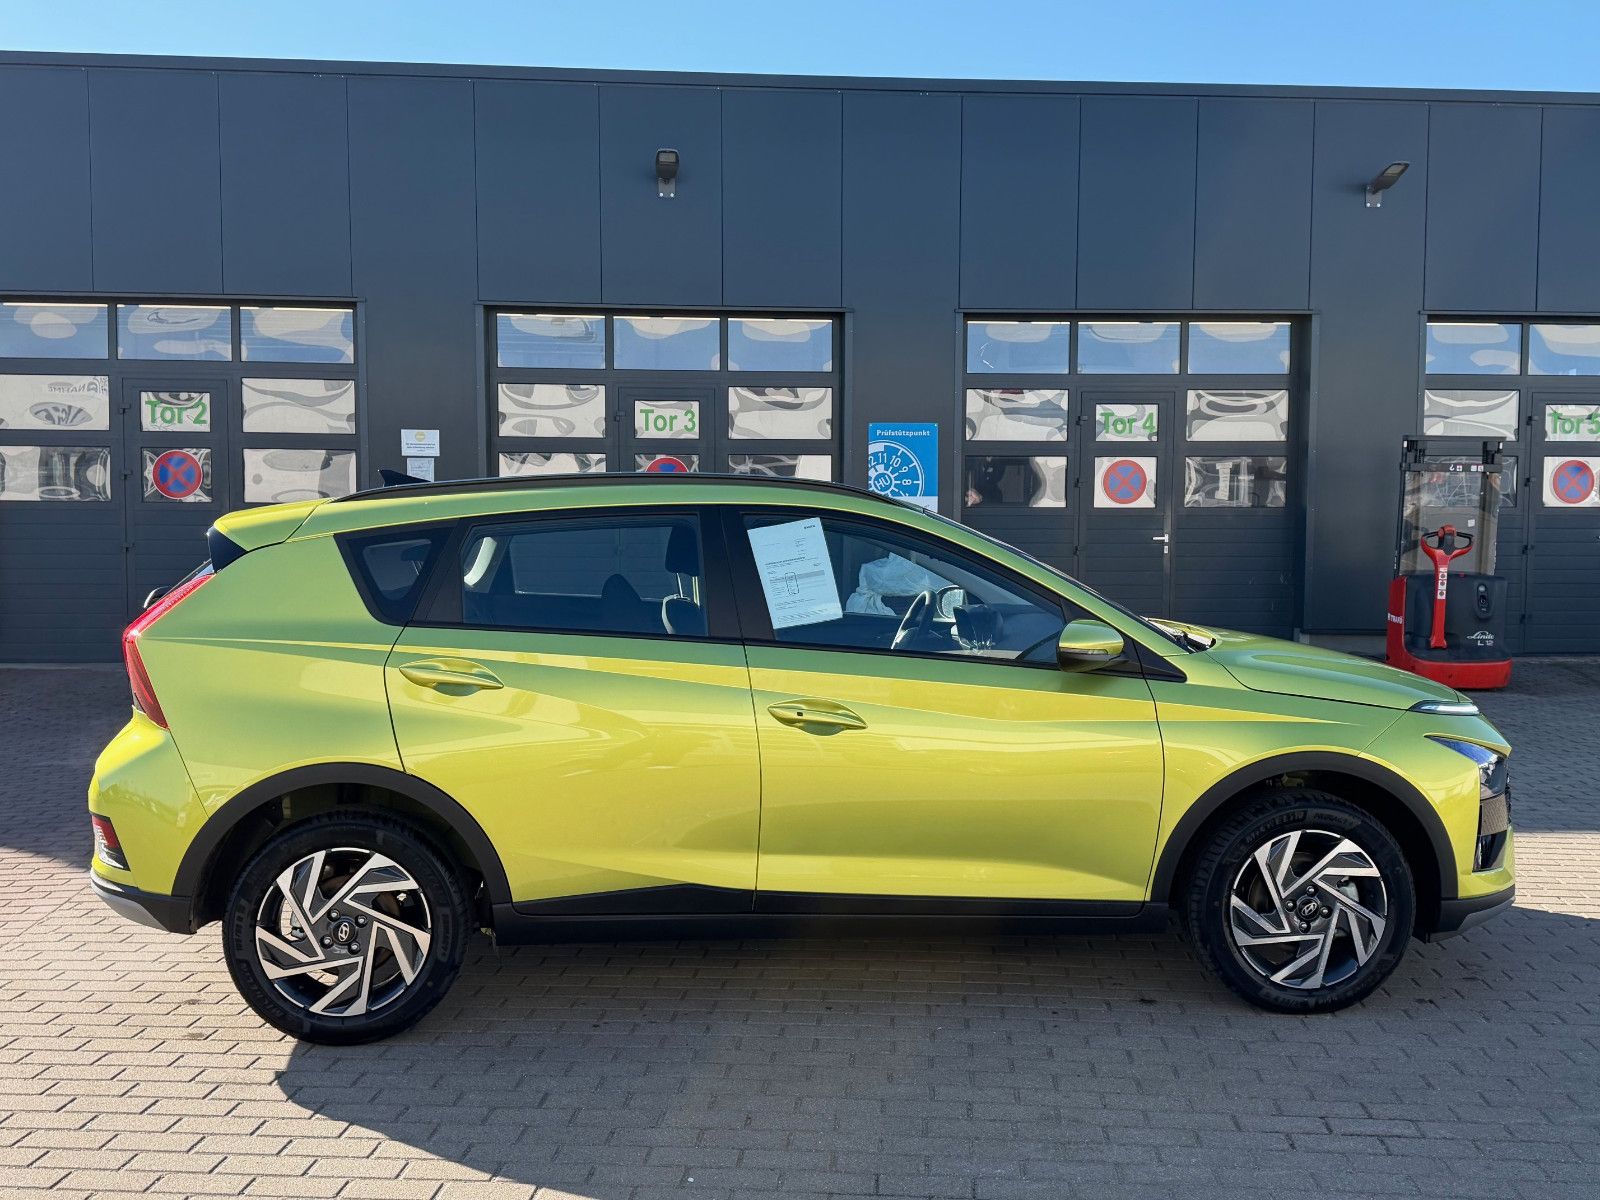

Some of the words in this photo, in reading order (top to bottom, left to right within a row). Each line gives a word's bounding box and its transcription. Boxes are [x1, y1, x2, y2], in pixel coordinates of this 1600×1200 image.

[145, 400, 187, 425] Tor
[193, 399, 208, 425] 2
[640, 408, 678, 432] Tor
[684, 408, 696, 433] 3
[1099, 412, 1138, 434] Tor
[1142, 412, 1155, 433] 4
[1548, 412, 1585, 434] Tor
[1588, 412, 1600, 435] 5
[877, 429, 930, 437] Prüfstützpunkt
[878, 453, 887, 463] 11
[889, 455, 901, 467] 10
[875, 475, 890, 489] HU
[1466, 630, 1495, 640] Linde
